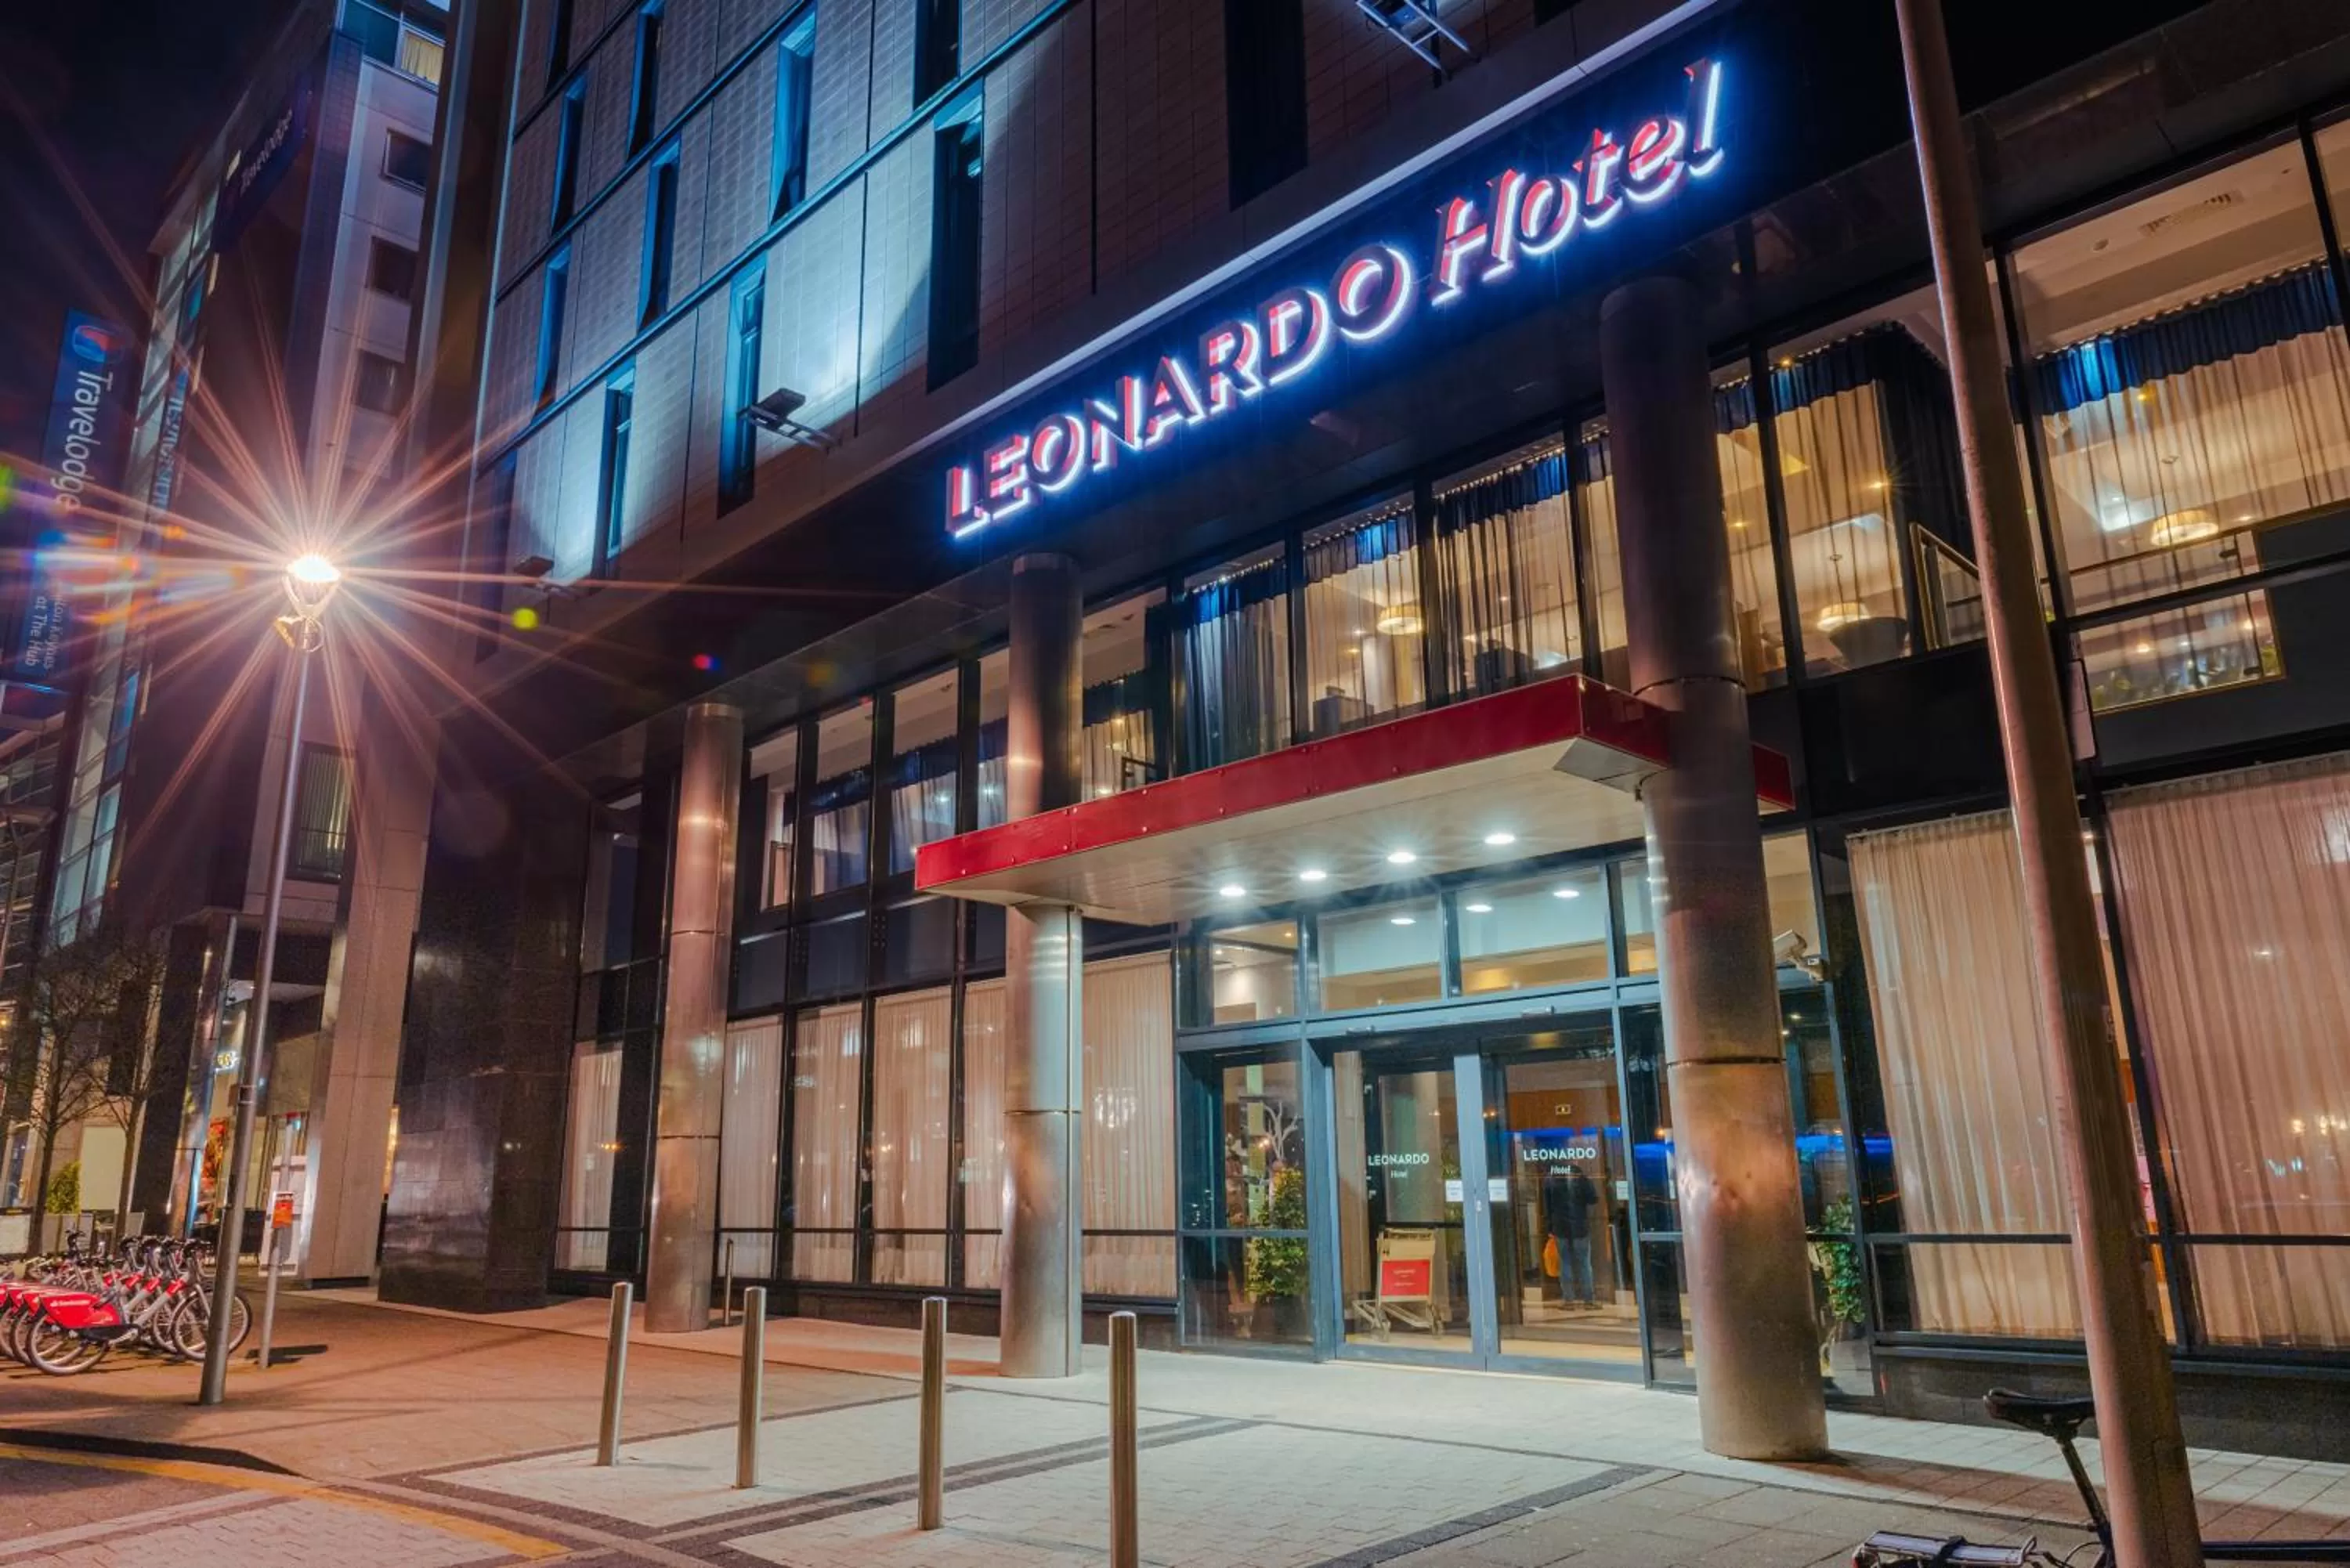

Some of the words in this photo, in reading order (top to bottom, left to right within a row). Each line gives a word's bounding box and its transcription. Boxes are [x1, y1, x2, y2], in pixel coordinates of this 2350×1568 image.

[945, 243, 1412, 539] LEONARDO
[1429, 56, 1723, 307] Hotel
[49, 370, 114, 512] Travelodge
[34, 595, 48, 610] at
[30, 614, 48, 637] The
[25, 640, 43, 666] Hub
[1367, 1153, 1430, 1166] LEONARDO
[1523, 1147, 1596, 1161] LEONARDO
